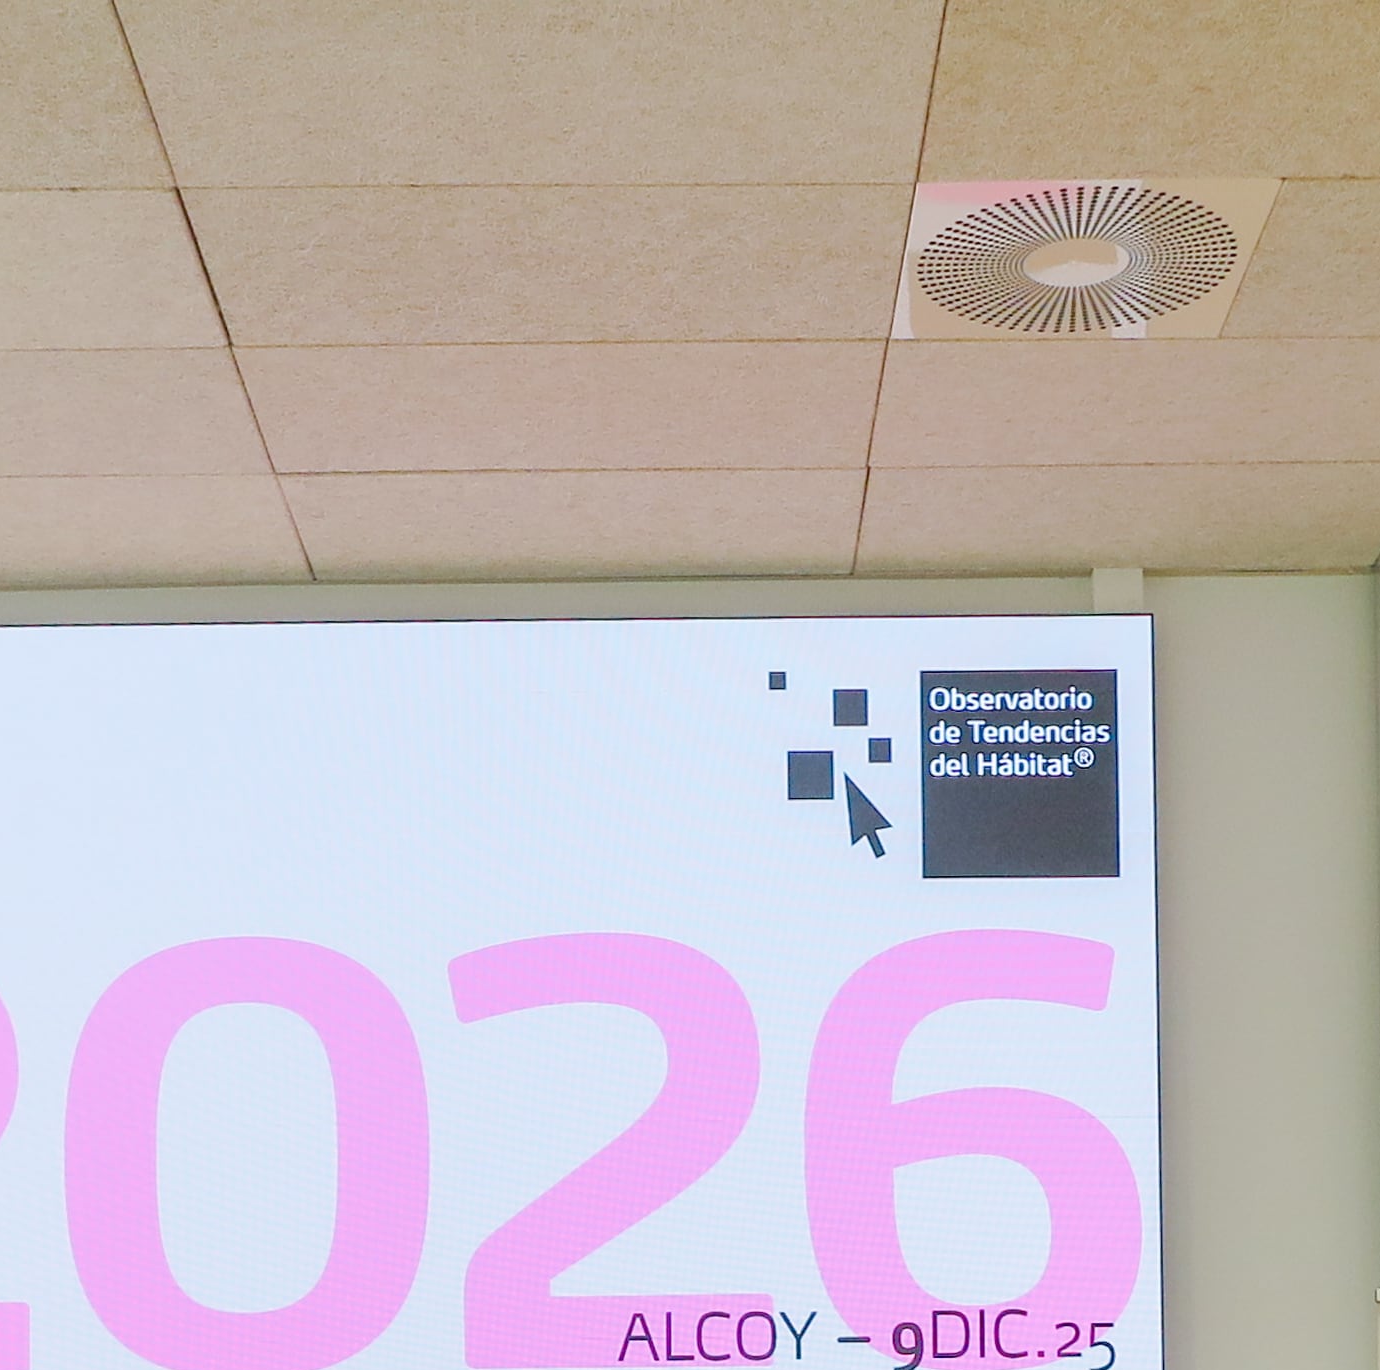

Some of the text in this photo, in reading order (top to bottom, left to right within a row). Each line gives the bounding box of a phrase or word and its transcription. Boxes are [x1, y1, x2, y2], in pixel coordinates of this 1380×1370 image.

[928, 685, 1093, 711] Observatorio
[928, 719, 1111, 744] de Tendencias
[929, 752, 970, 777] del
[617, 1310, 818, 1362] ALCOY
